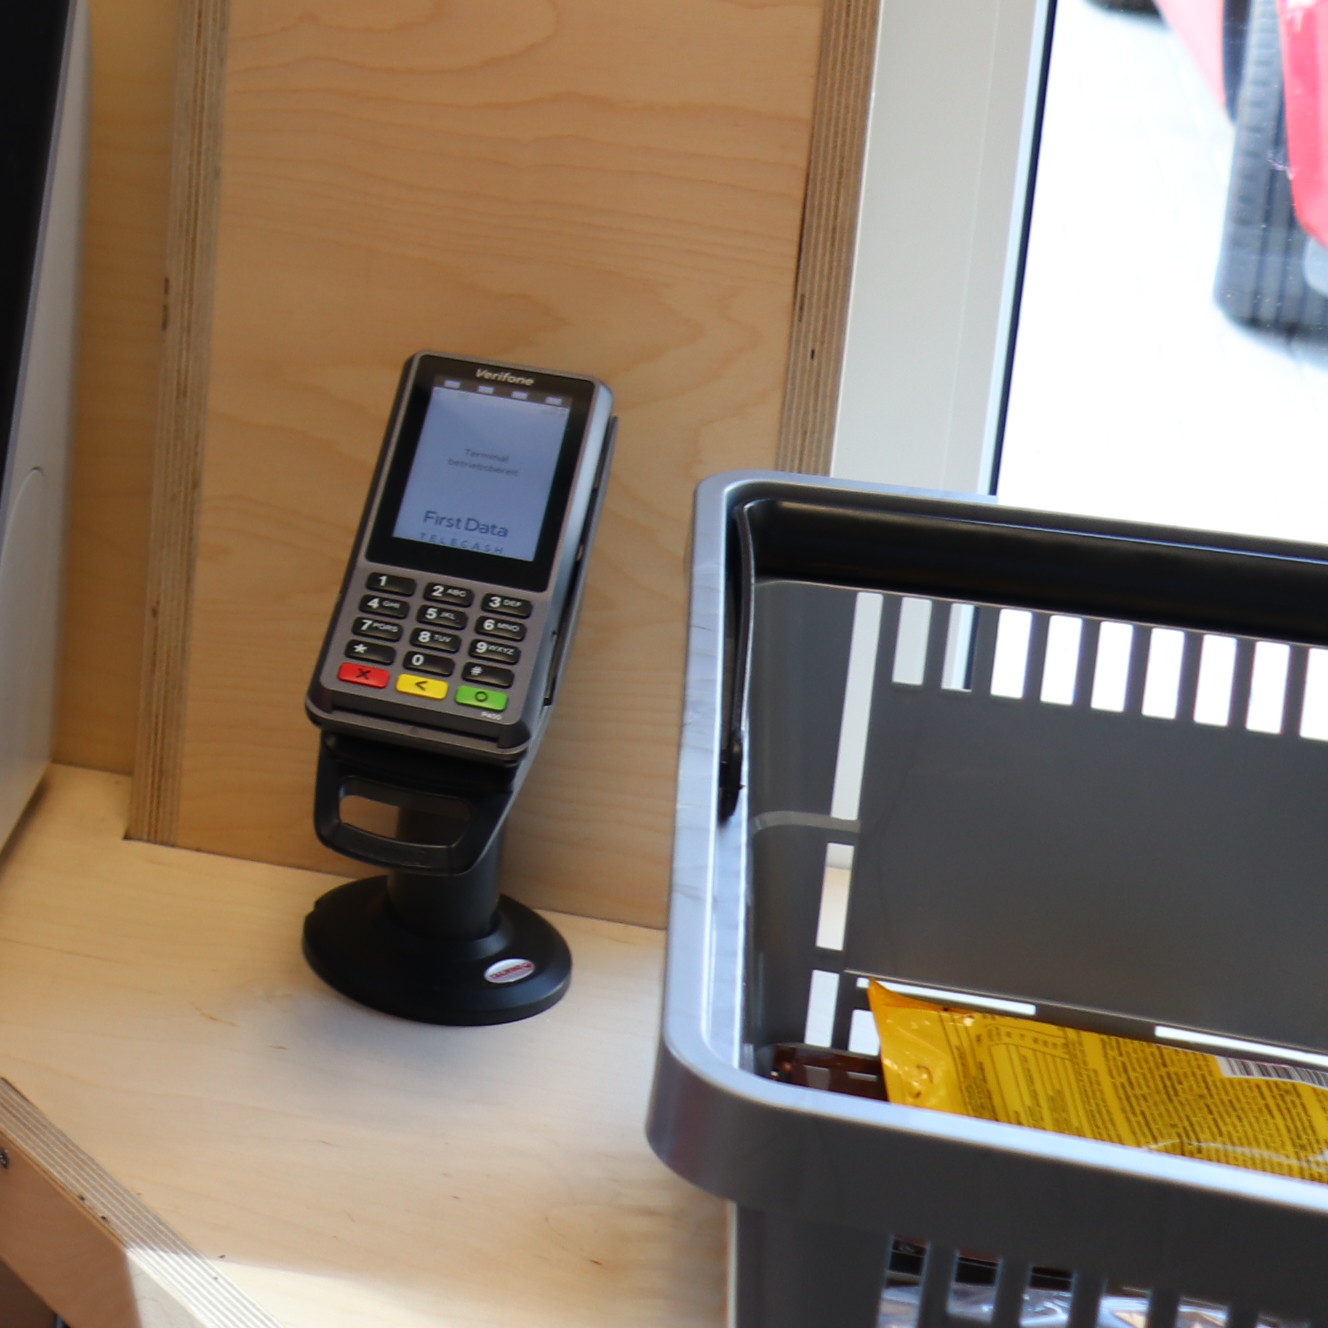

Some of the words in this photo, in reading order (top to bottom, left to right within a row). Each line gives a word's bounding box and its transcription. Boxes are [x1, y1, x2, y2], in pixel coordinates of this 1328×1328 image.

[475, 368, 535, 387] Verifone
[422, 510, 462, 530] First
[463, 517, 509, 538] Data
[420, 532, 504, 555] TELECASH
[378, 575, 387, 587] 1
[432, 585, 444, 597] 2
[446, 588, 467, 598] ABC
[367, 597, 379, 609] 4
[382, 599, 400, 609] GHI
[489, 596, 501, 608] 3
[503, 598, 522, 608] DEF
[425, 607, 437, 619] 5
[361, 619, 373, 631] 7
[483, 619, 495, 630] 6
[497, 622, 520, 632] MNO
[418, 631, 431, 642] 8
[433, 633, 451, 643] TUV
[476, 642, 488, 654] 9
[412, 654, 424, 666] 0
